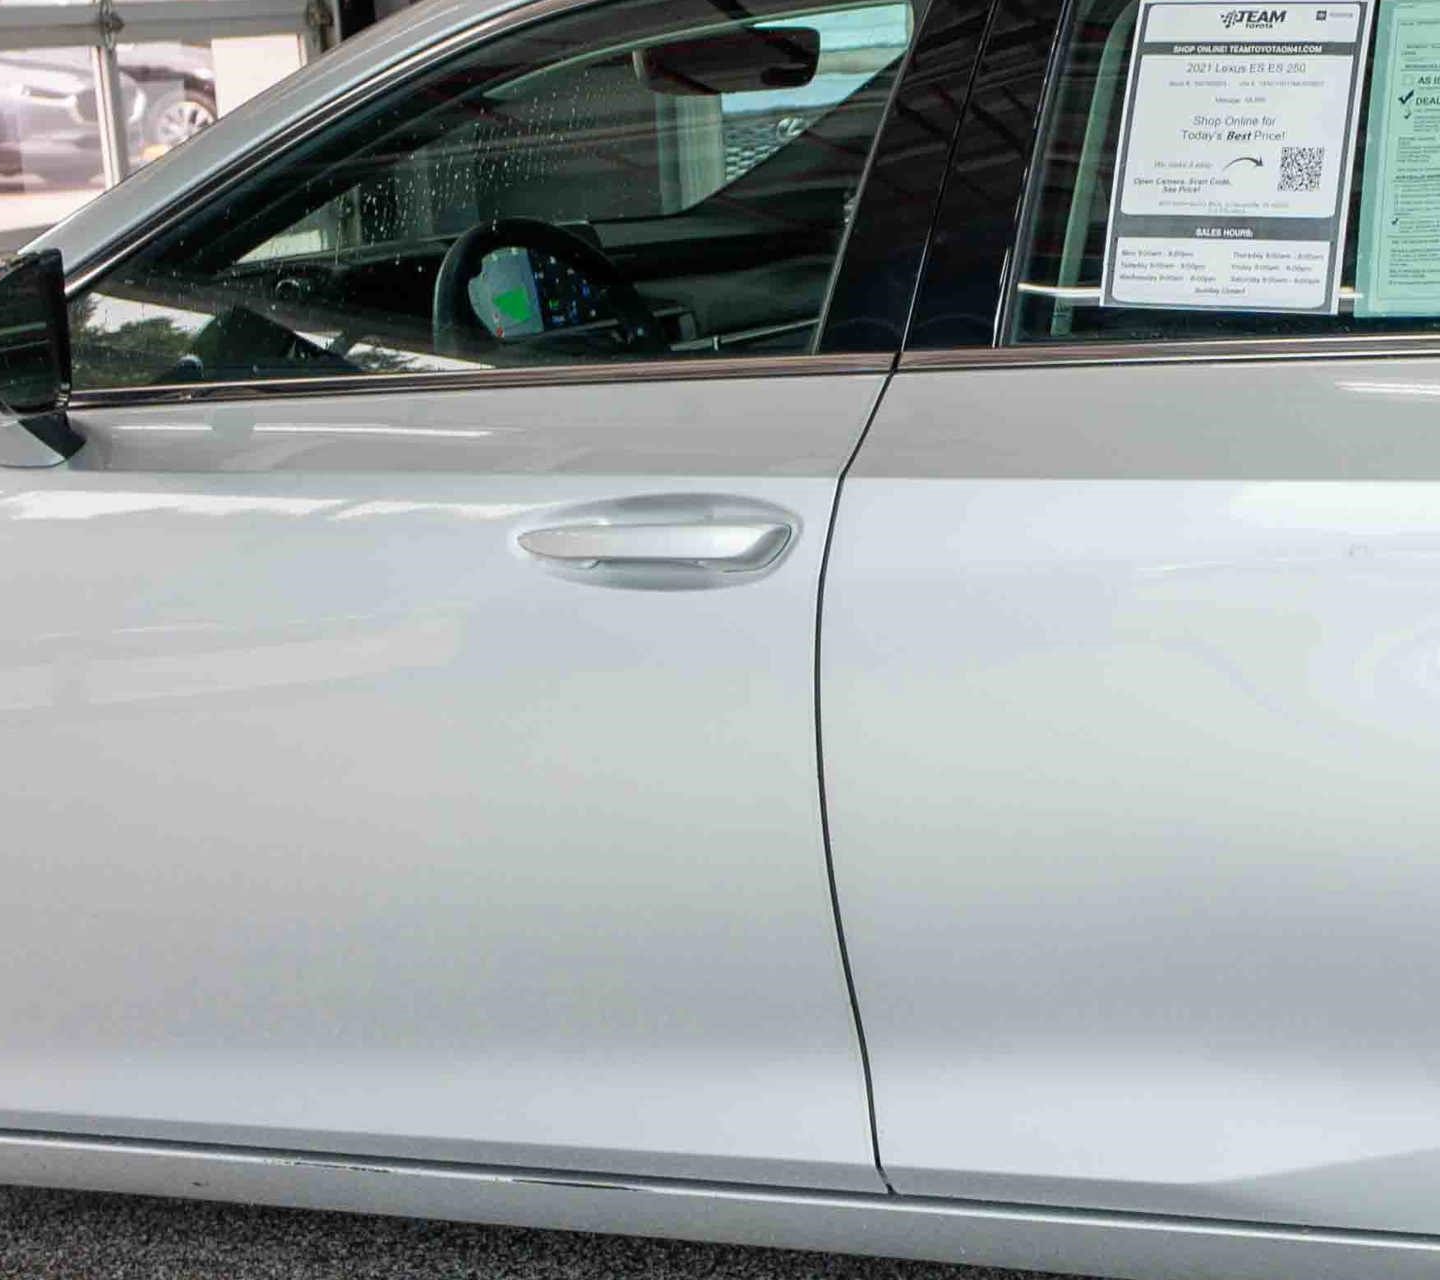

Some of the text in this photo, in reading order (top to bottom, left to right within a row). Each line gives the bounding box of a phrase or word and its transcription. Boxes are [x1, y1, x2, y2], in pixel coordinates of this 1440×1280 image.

[1237, 10, 1288, 23] TEAM
[1173, 45, 1195, 53] SHOP
[1229, 45, 1322, 54] TEAMTOYOTAON41.COM
[1185, 62, 1212, 73] 2021
[1215, 62, 1246, 74] Lexus
[1417, 76, 1431, 85] AS
[1193, 116, 1276, 128] Shop Online for
[1181, 130, 1286, 141] Today's Best Price!
[1133, 177, 1154, 186] Open
[1195, 228, 1253, 238] SALES HOURS:
